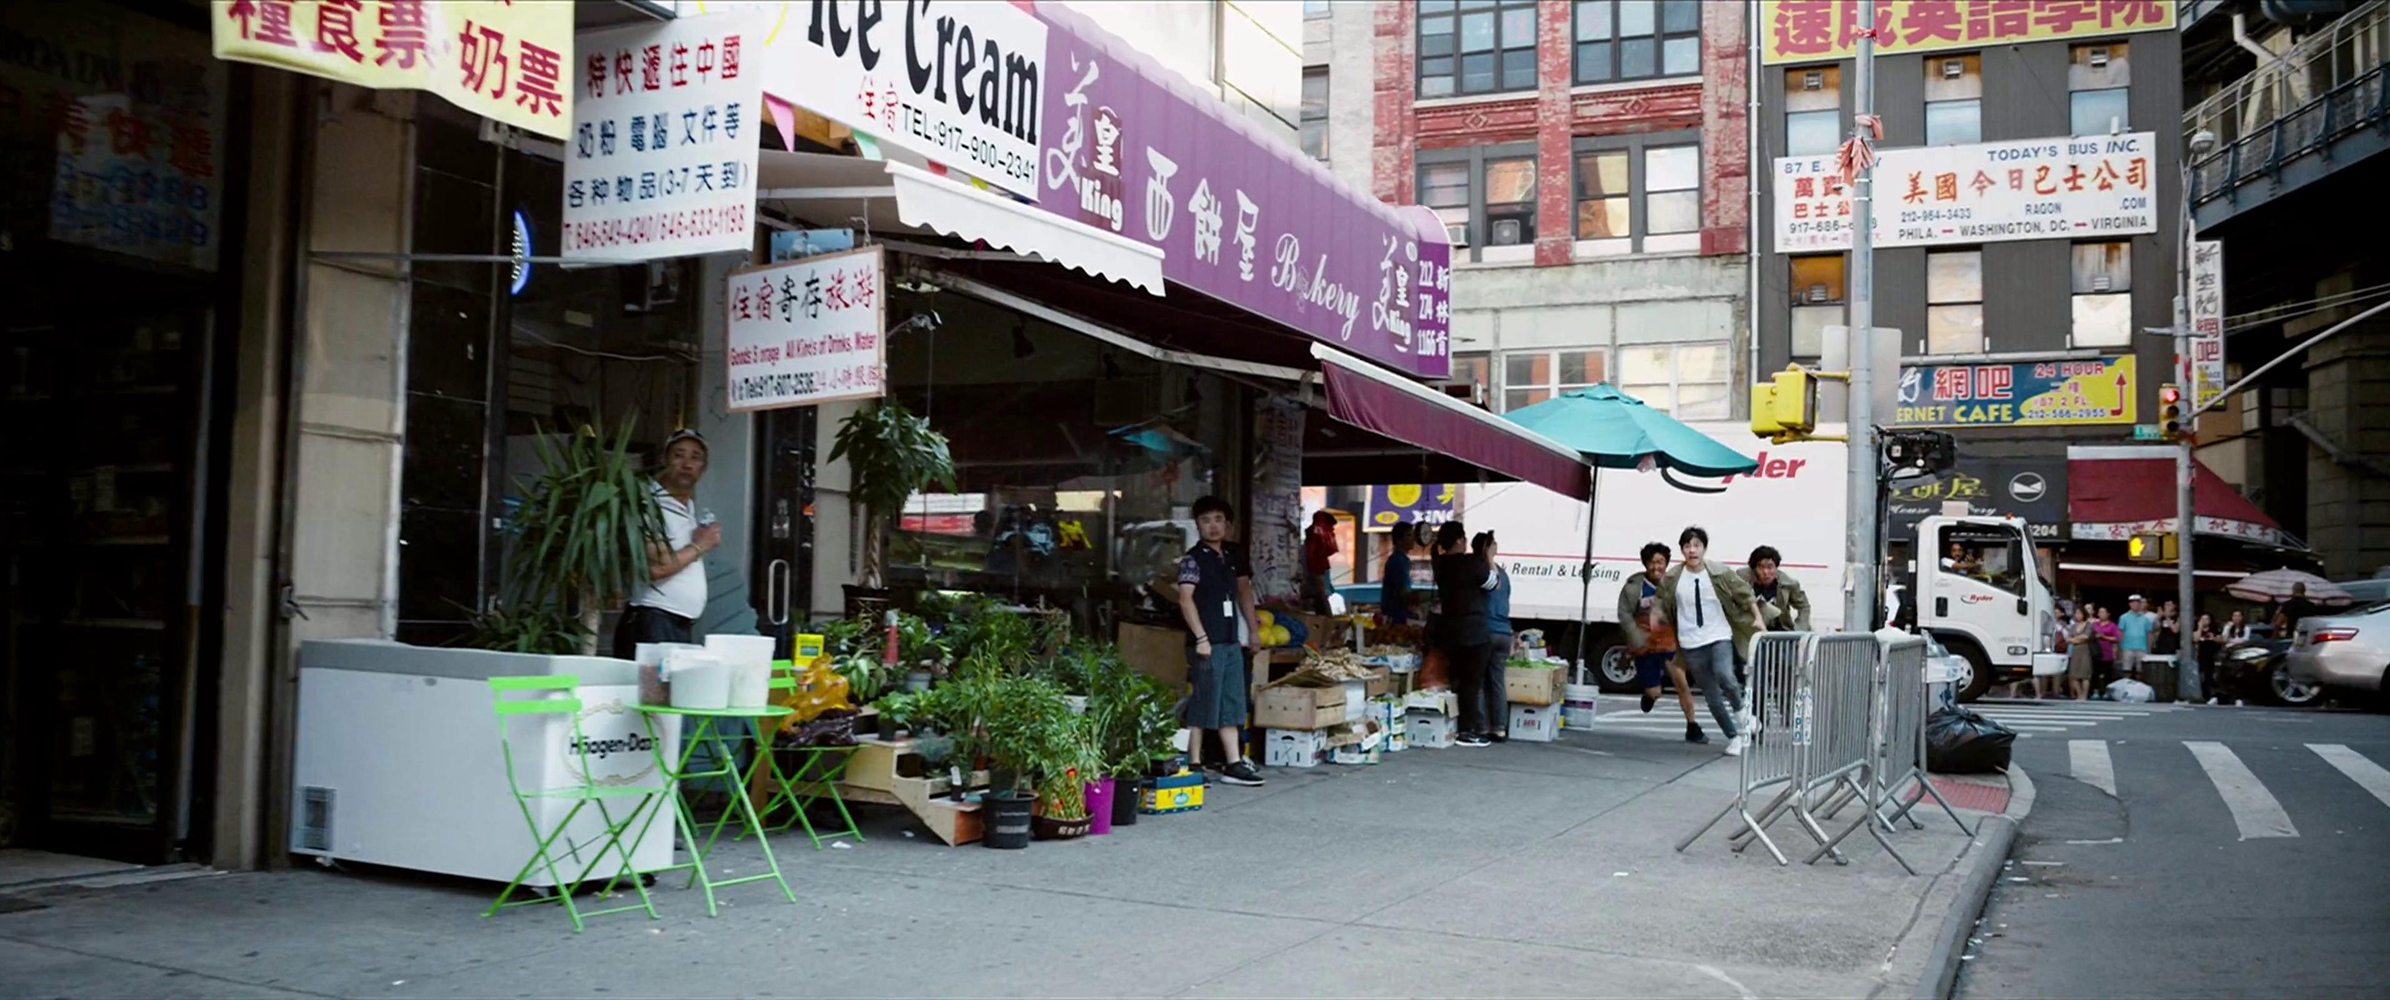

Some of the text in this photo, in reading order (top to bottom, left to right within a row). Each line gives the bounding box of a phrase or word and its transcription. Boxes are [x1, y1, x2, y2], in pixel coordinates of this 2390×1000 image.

[905, 0, 1039, 146] Cream
[1987, 138, 2142, 162] TODAY'S BUS INC.
[1785, 163, 1803, 174] 87
[1081, 176, 1124, 232] King
[1790, 217, 1878, 234] 917-686-
[2091, 215, 2148, 229] VIRGINIA
[1389, 309, 1411, 345] King
[2034, 361, 2105, 378] 24 HOUR
[1933, 366, 2014, 401] 網吧
[1953, 404, 2014, 422] CAFE
[1511, 563, 1553, 577] Rental
[1557, 564, 1567, 577] &
[1570, 564, 1621, 581] Lesing
